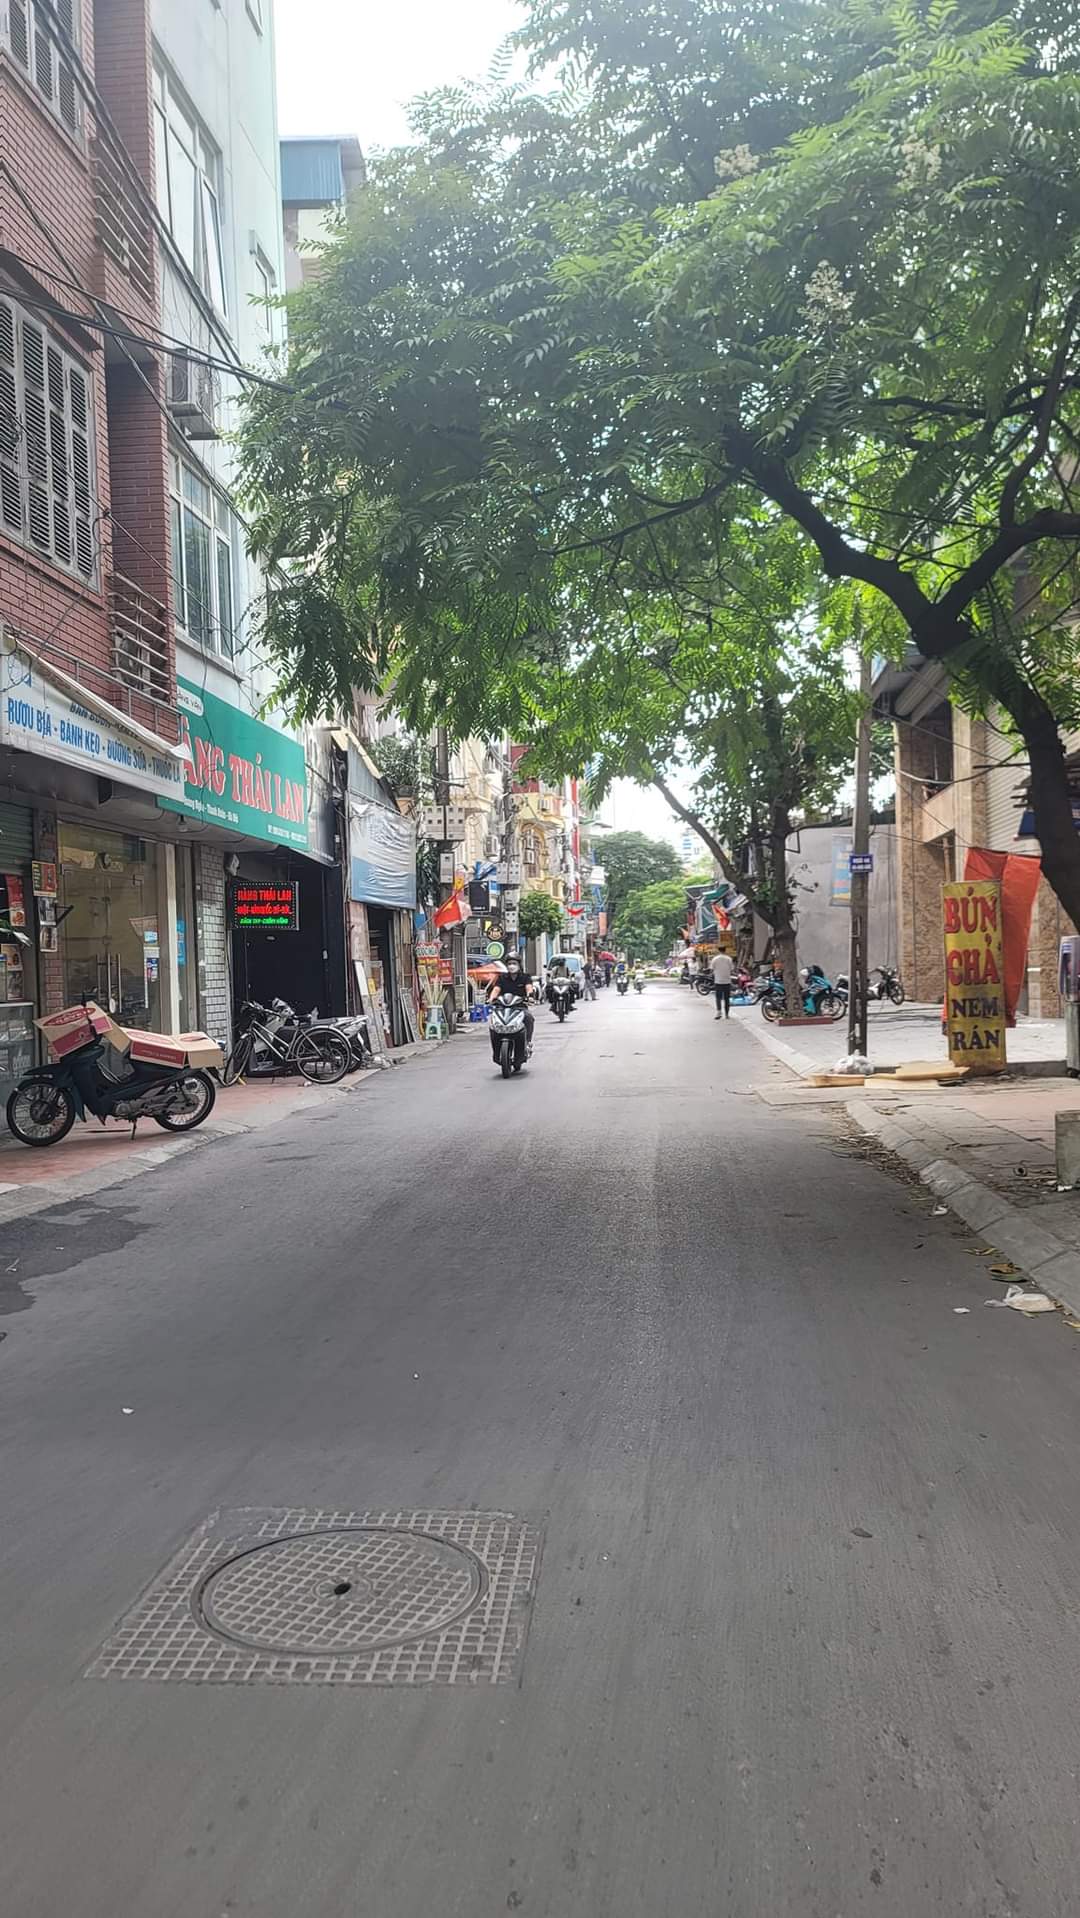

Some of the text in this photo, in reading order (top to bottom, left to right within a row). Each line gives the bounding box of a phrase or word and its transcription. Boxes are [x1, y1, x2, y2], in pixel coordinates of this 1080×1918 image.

[8, 698, 33, 732] RƯỢU
[60, 718, 83, 748] BÁNH
[85, 731, 100, 758] KẸO
[107, 738, 131, 766] ĐƯỜNG
[180, 715, 226, 796] ÀNG
[229, 752, 273, 814] THÁI
[274, 774, 305, 825] LAN
[944, 886, 997, 934] BÚN
[946, 933, 1000, 986] CHẢ
[952, 997, 999, 1019] NEM
[952, 1025, 1000, 1050] RÁN
